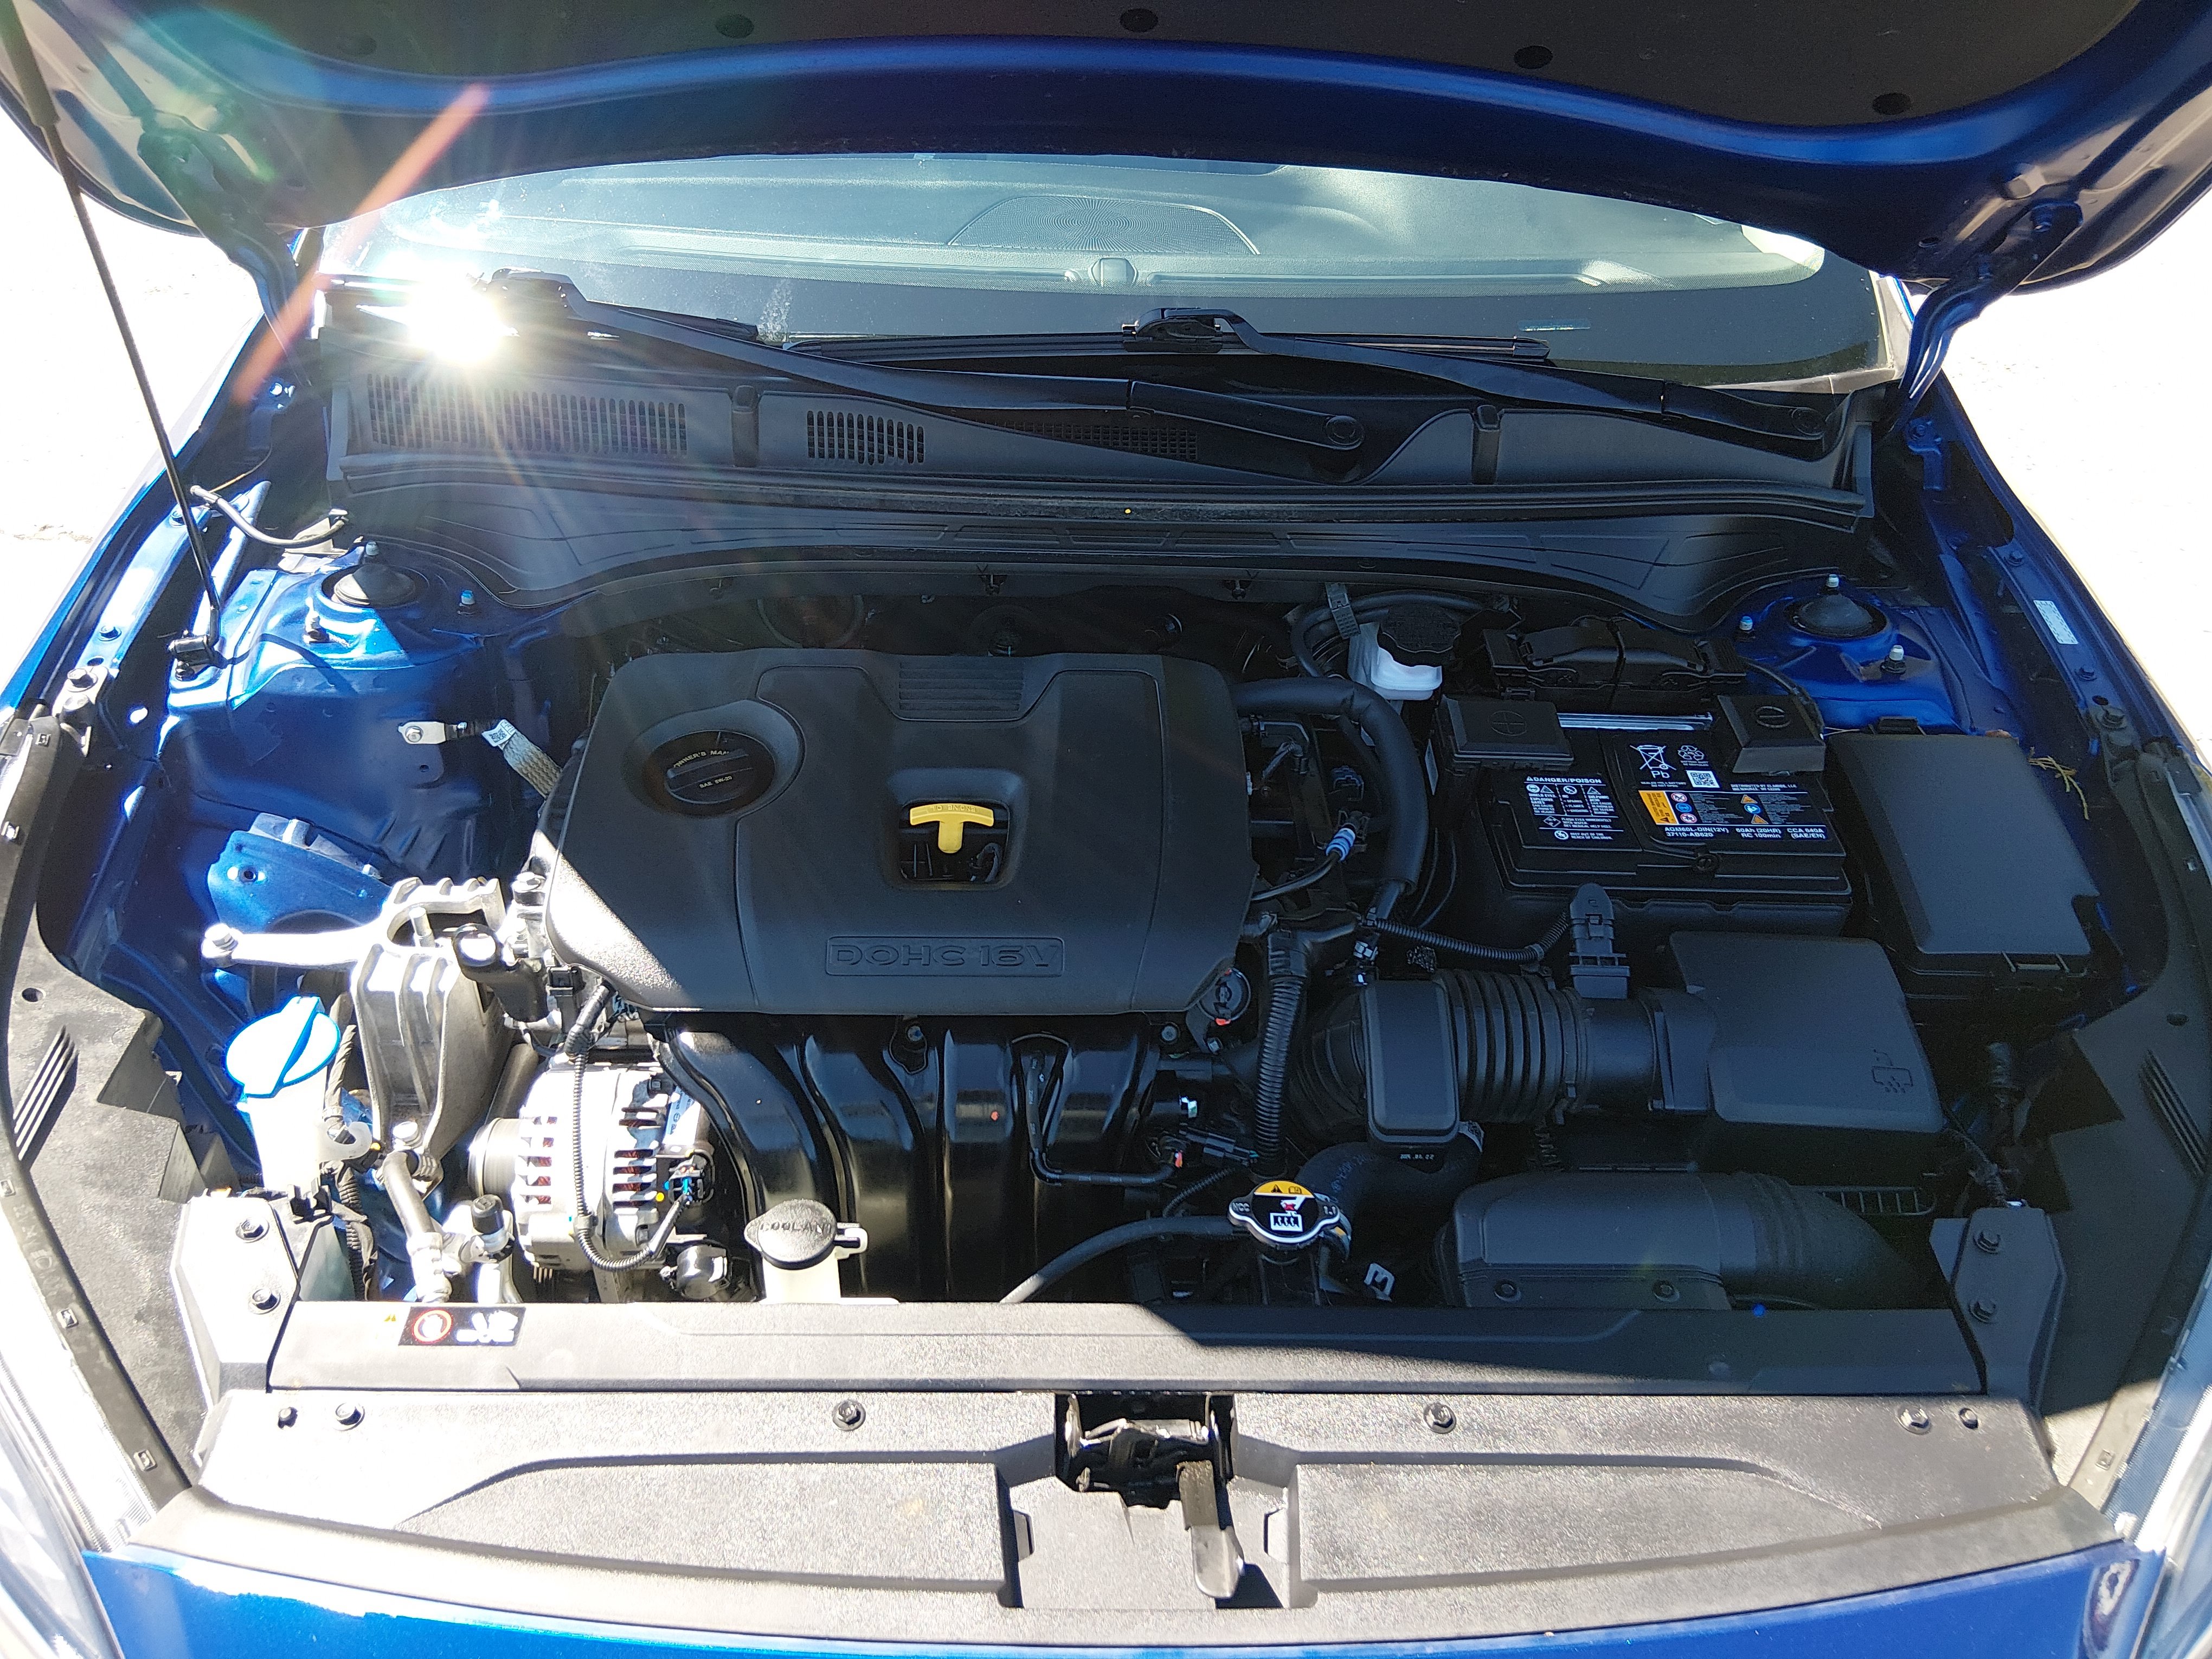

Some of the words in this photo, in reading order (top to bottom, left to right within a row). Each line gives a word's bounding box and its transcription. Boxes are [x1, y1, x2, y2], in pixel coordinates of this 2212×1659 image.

[1650, 770, 1670, 779] Pb
[829, 944, 966, 966] DOHC
[978, 944, 1059, 967] 16V
